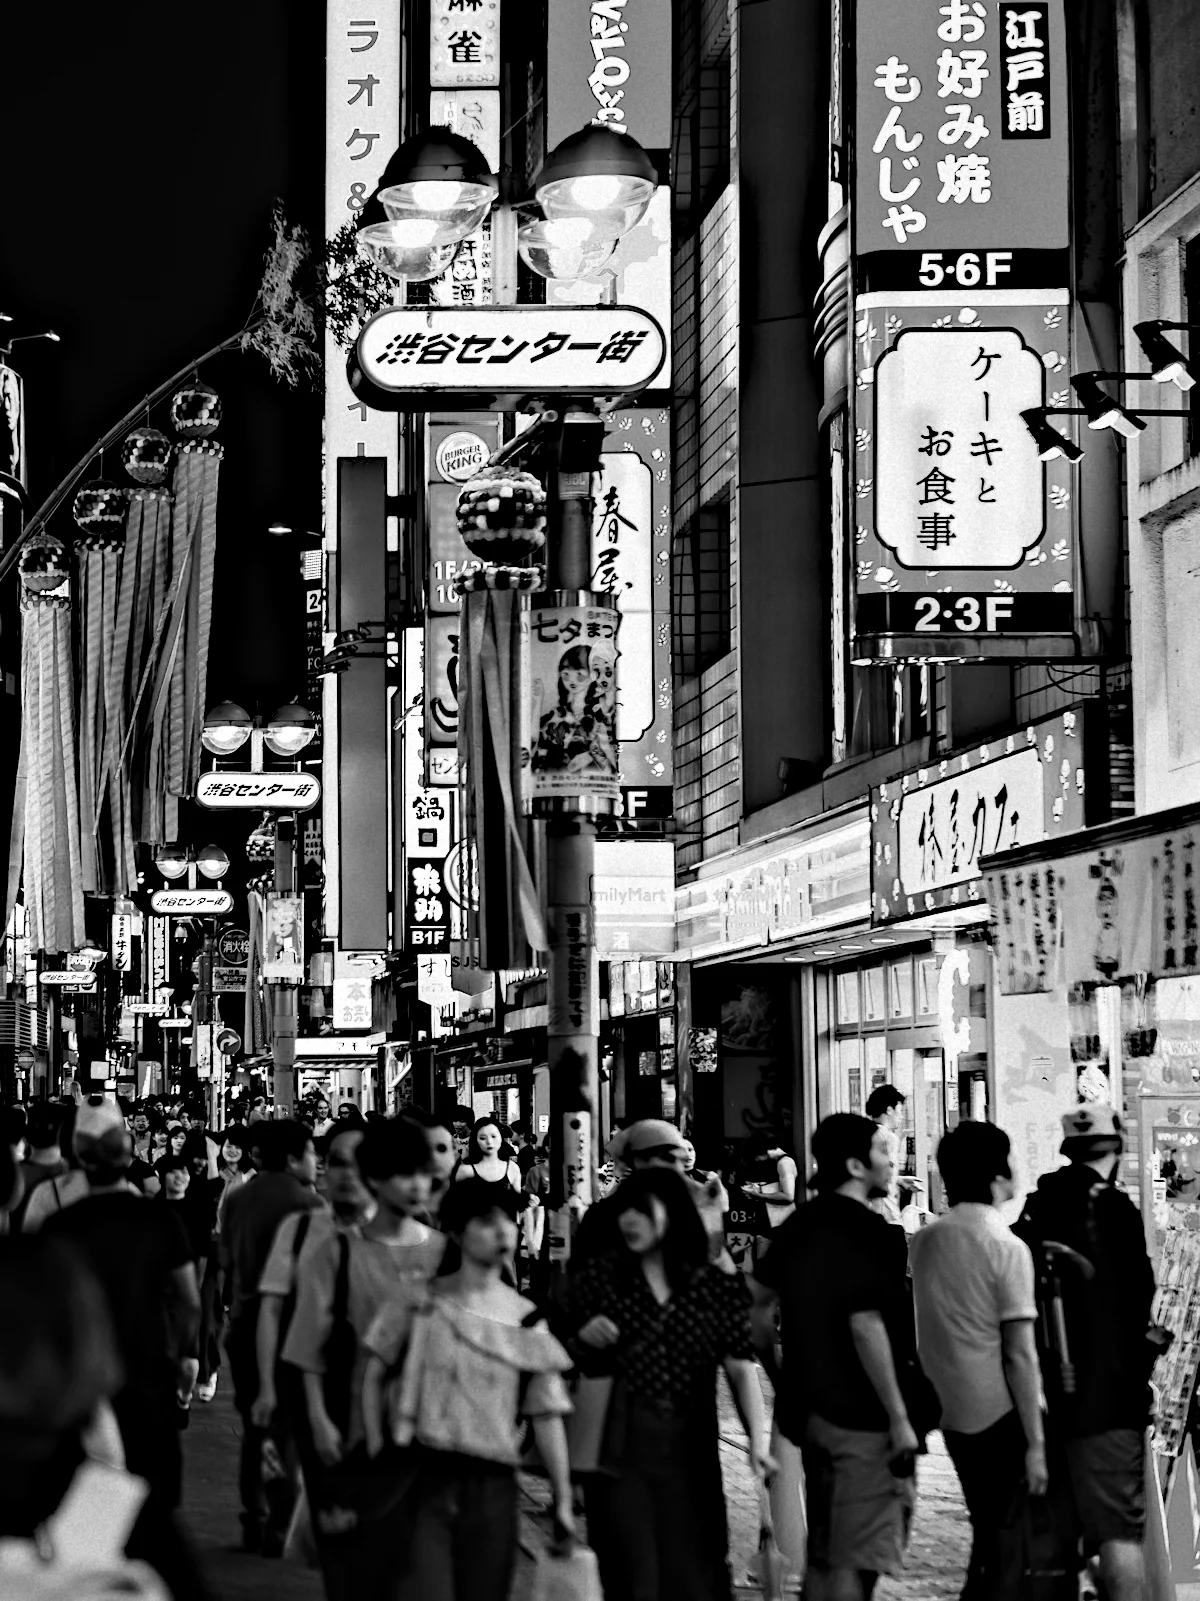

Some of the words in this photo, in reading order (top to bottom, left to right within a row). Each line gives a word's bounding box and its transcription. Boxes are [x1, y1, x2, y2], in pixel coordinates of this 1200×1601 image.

[1005, 10, 1045, 132] 江戸前
[872, 55, 927, 244] もんじゃ
[375, 331, 650, 365] 渋谷センター街
[970, 346, 1003, 504] ケーキと
[443, 444, 481, 462] BURGER
[446, 453, 483, 473] KING
[916, 425, 956, 550] お食事
[203, 783, 313, 797] 渋谷センター街
[156, 896, 227, 907] 渋谷センター街
[223, 940, 249, 953] 消火栓
[412, 931, 445, 945] B1F
